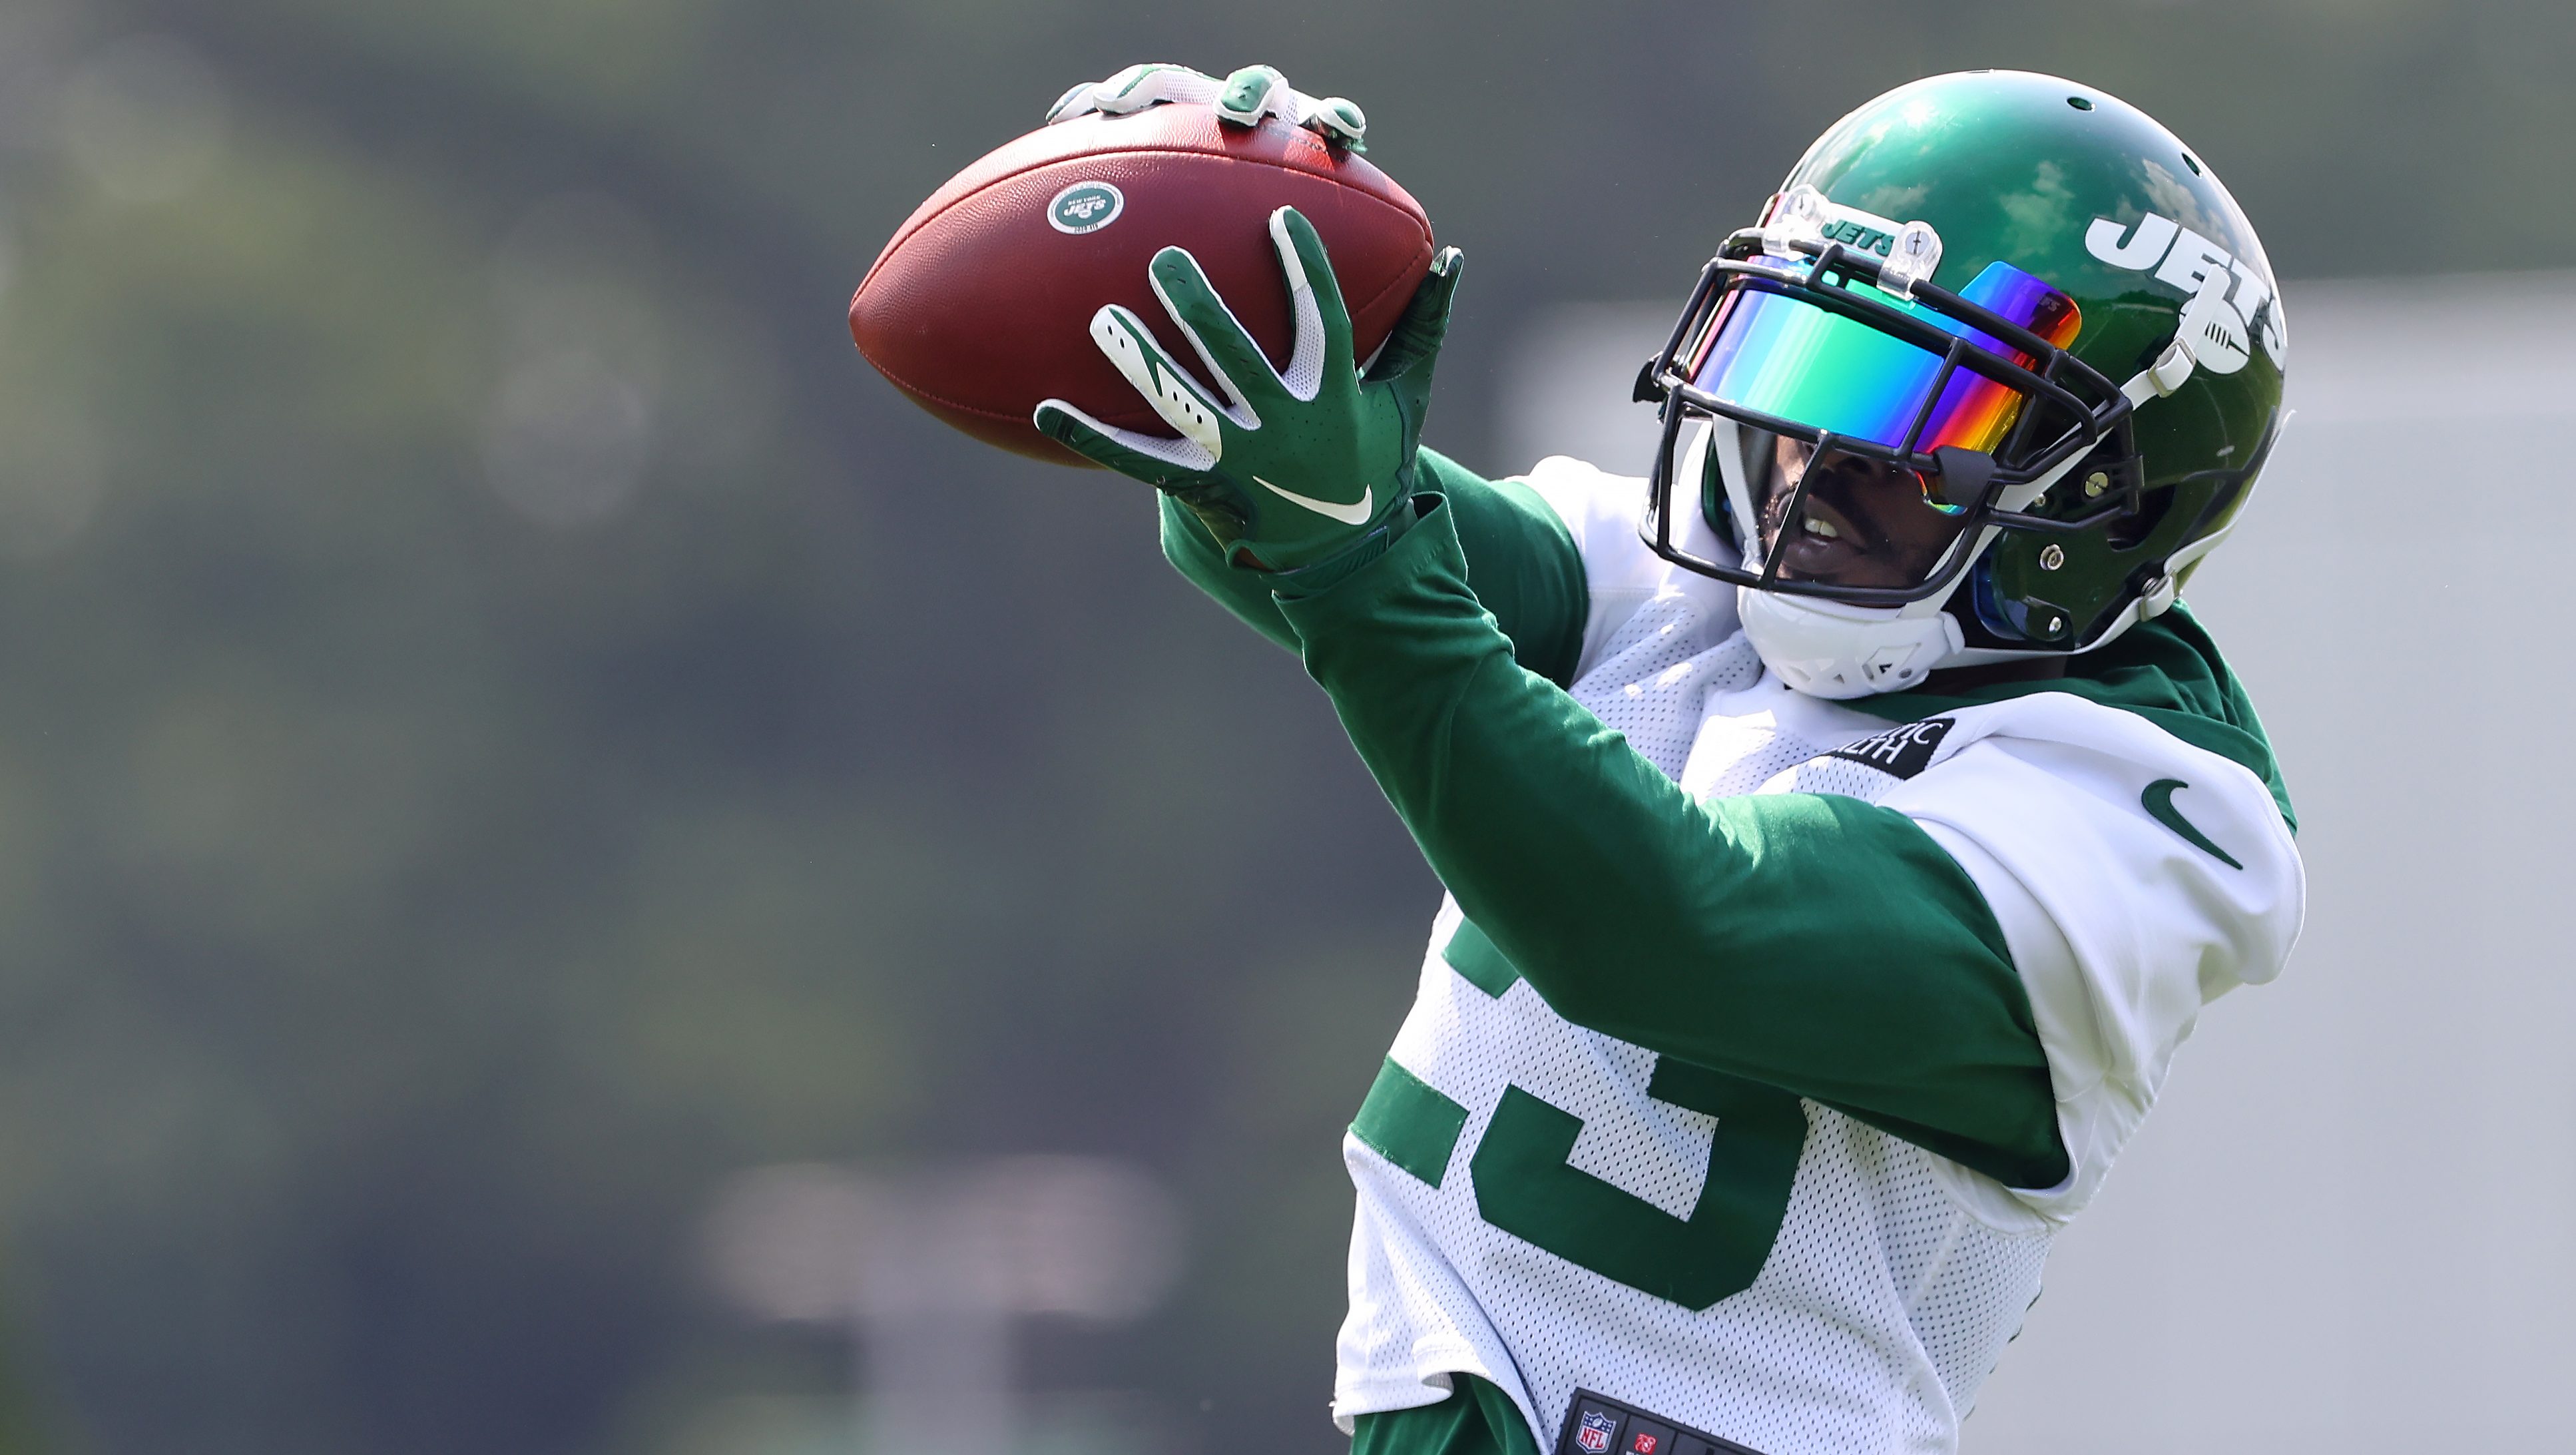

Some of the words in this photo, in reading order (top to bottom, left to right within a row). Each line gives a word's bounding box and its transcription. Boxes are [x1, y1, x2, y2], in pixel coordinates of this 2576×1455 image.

[1063, 198, 1107, 216] JETS
[1821, 219, 1896, 257] JETS
[2085, 212, 2288, 372] JETS
[1580, 1427, 1604, 1448] NFL
